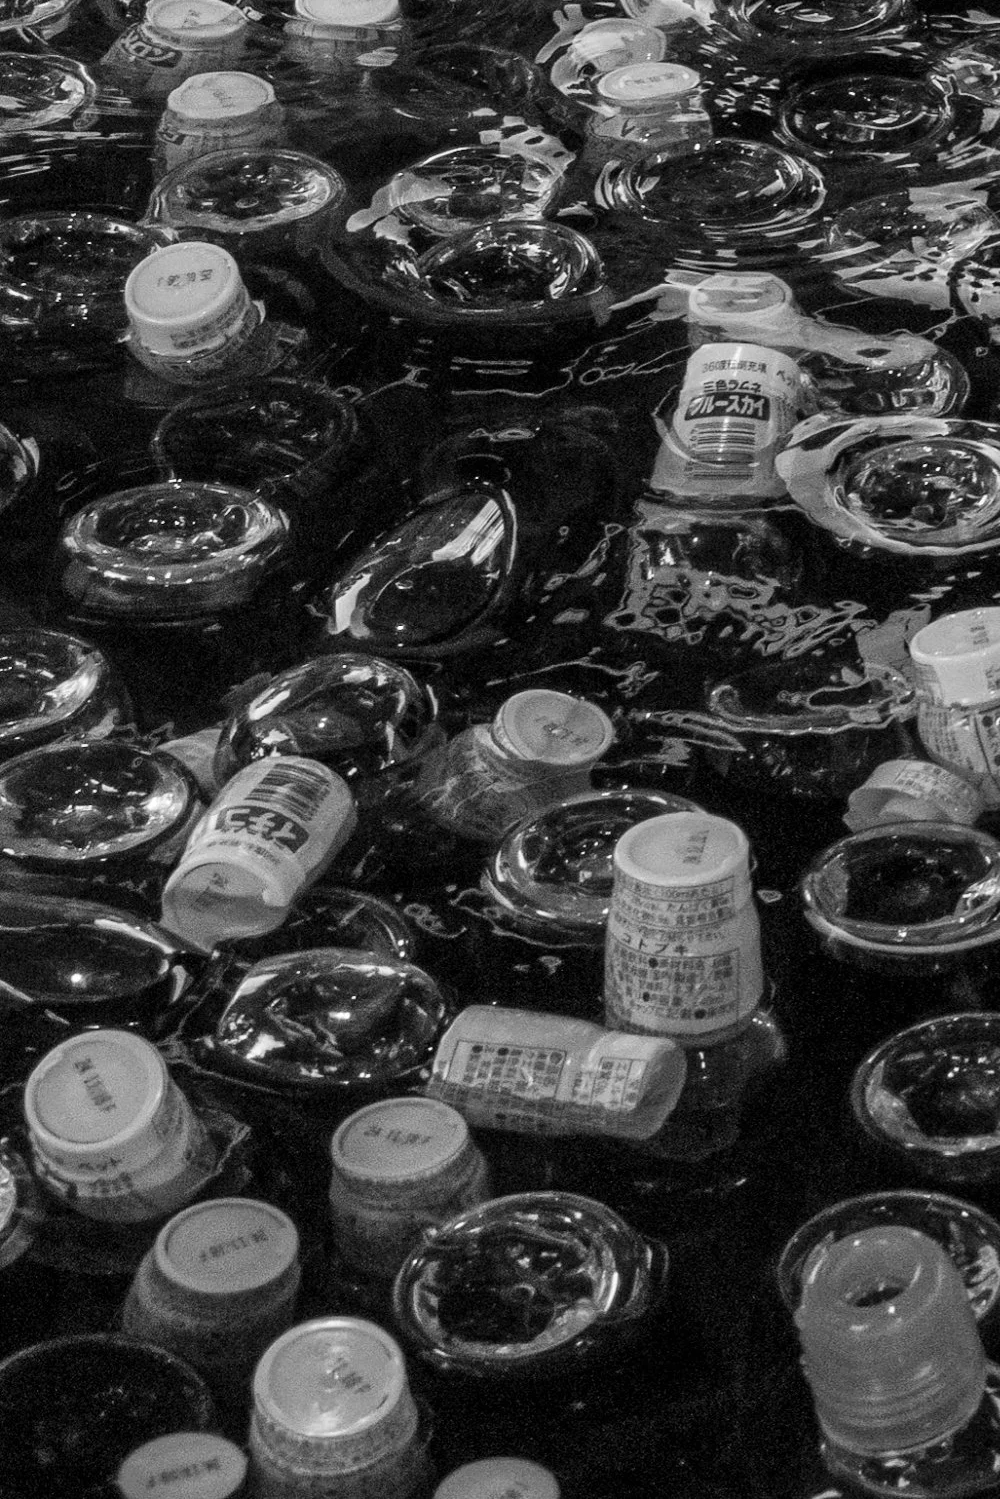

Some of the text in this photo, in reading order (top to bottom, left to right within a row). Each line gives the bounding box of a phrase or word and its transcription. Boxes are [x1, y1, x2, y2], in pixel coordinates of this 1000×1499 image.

[703, 379, 762, 395] 三色ラムネ
[689, 394, 765, 418] ブルースカイ
